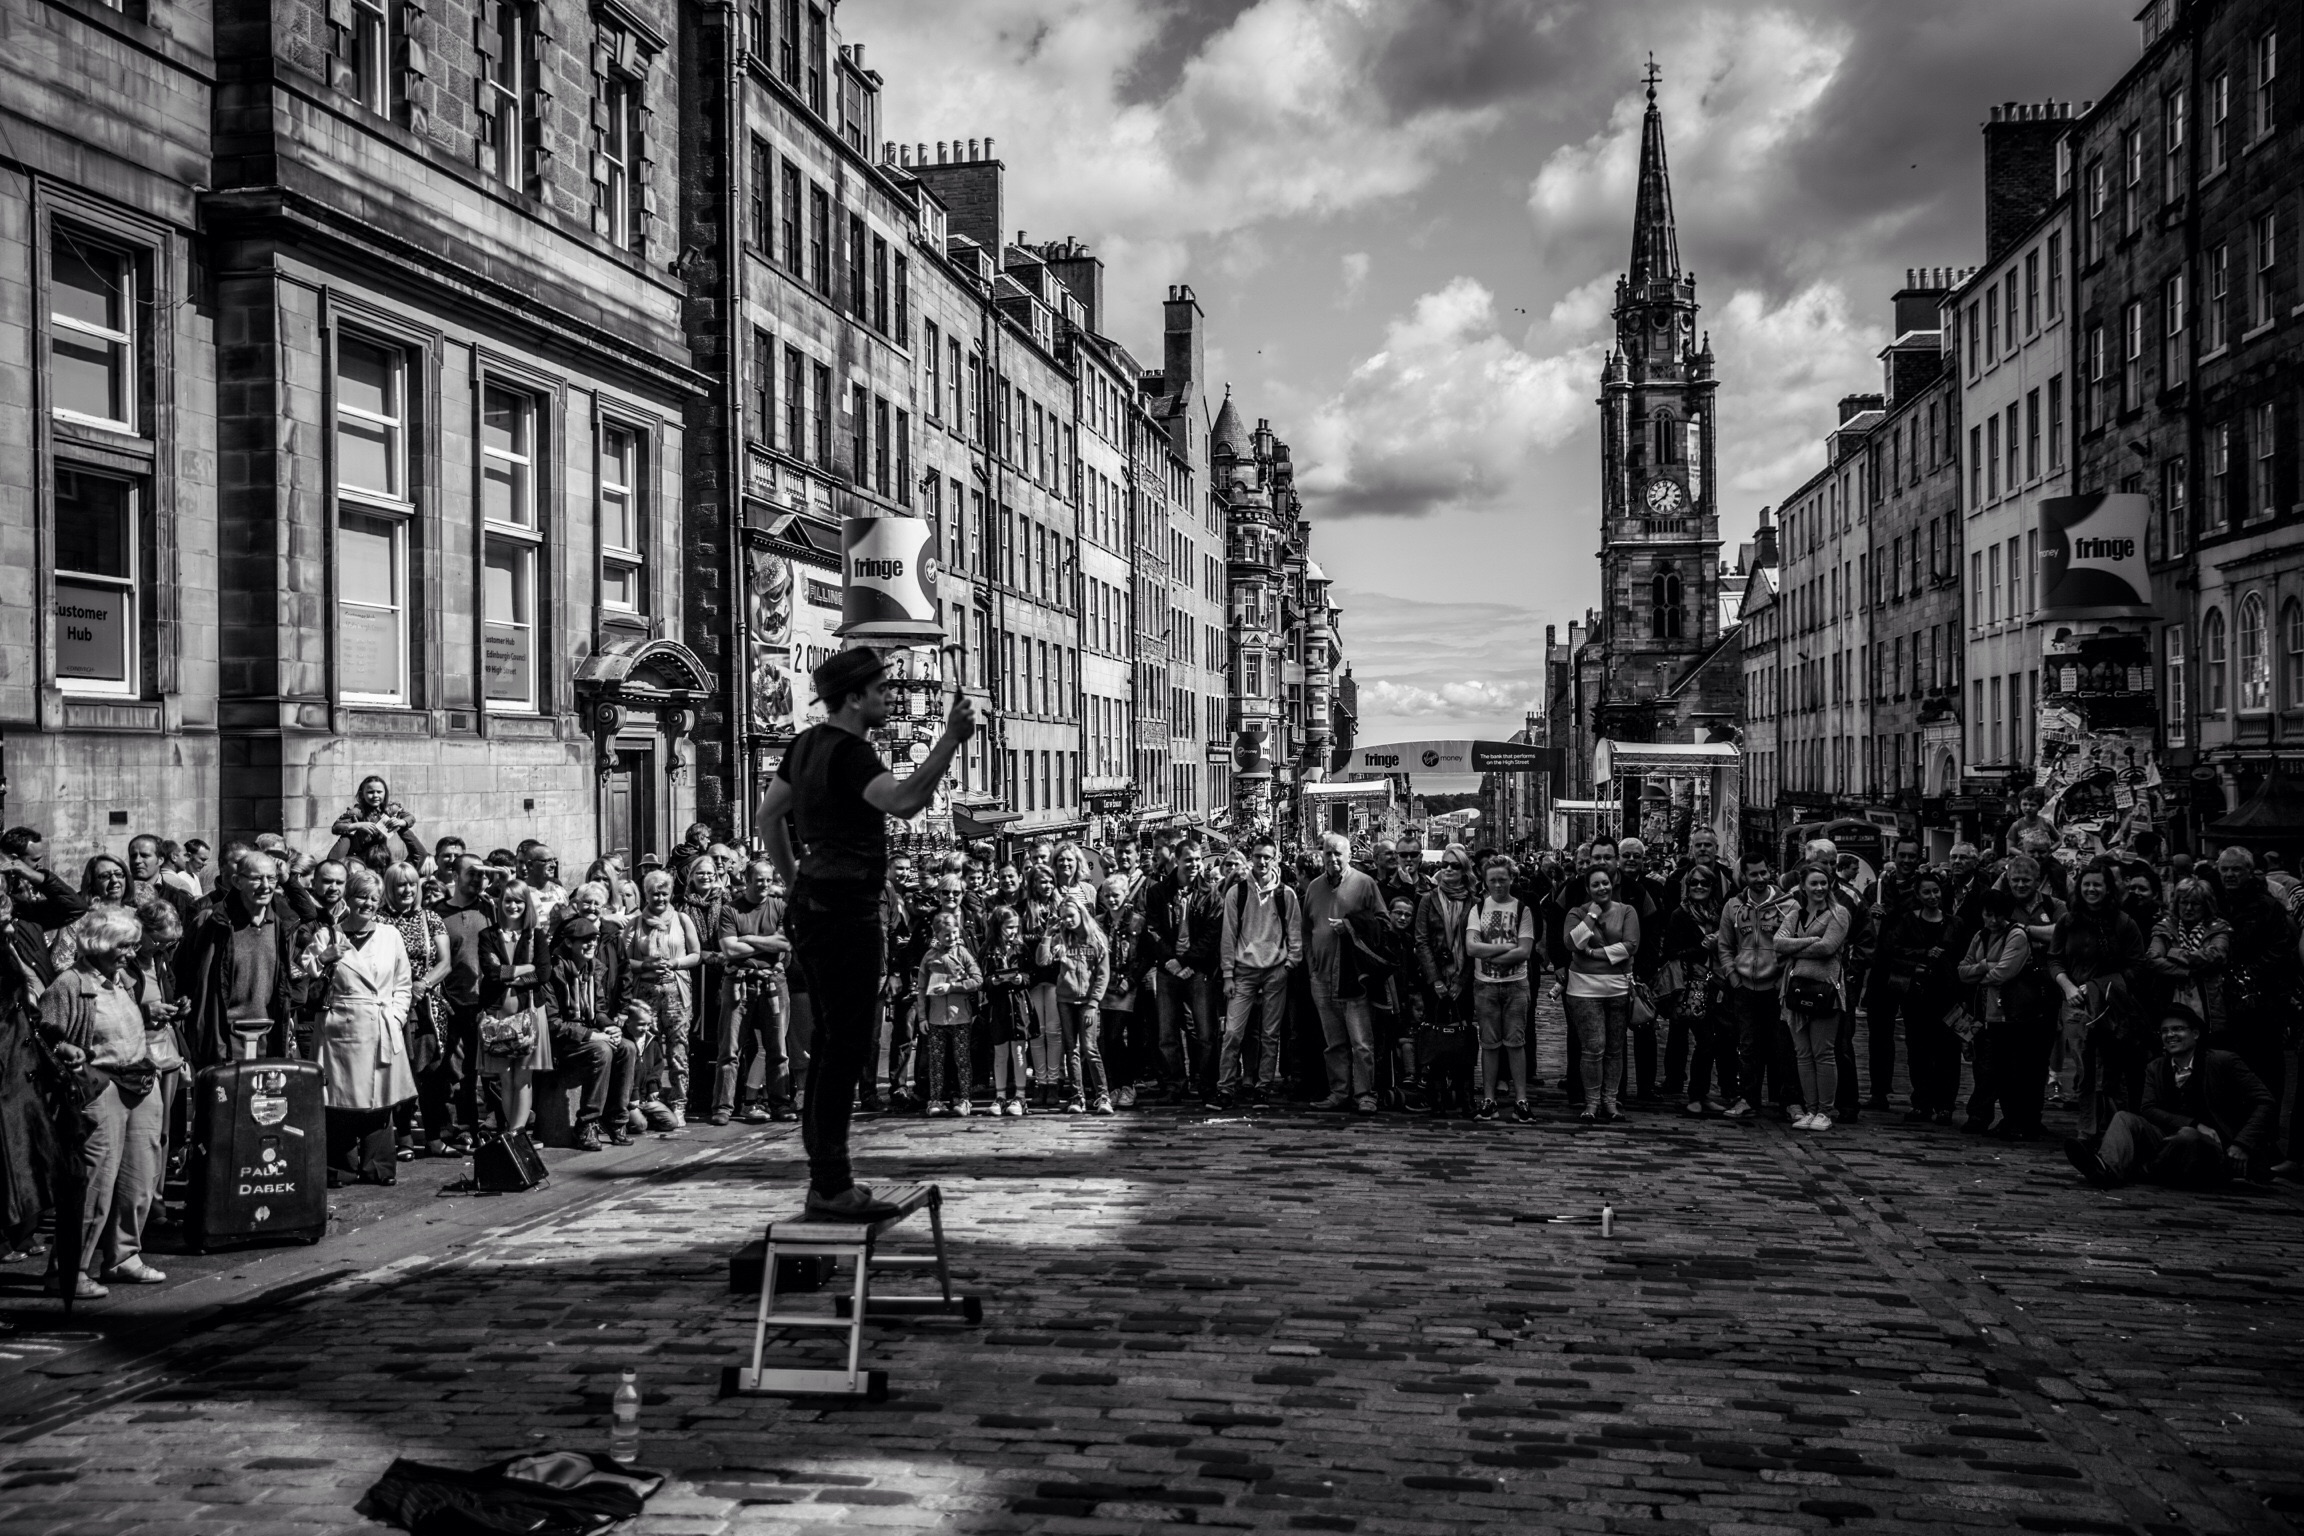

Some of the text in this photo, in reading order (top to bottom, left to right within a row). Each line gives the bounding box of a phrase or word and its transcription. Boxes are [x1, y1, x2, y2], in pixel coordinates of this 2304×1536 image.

[2075, 537, 2135, 562] fringe
[853, 557, 904, 581] fringe
[67, 625, 93, 642] Hub
[794, 642, 803, 673] 2
[1365, 753, 1399, 768] fringe
[1440, 755, 1463, 763] money
[238, 1182, 297, 1196] DABEK
